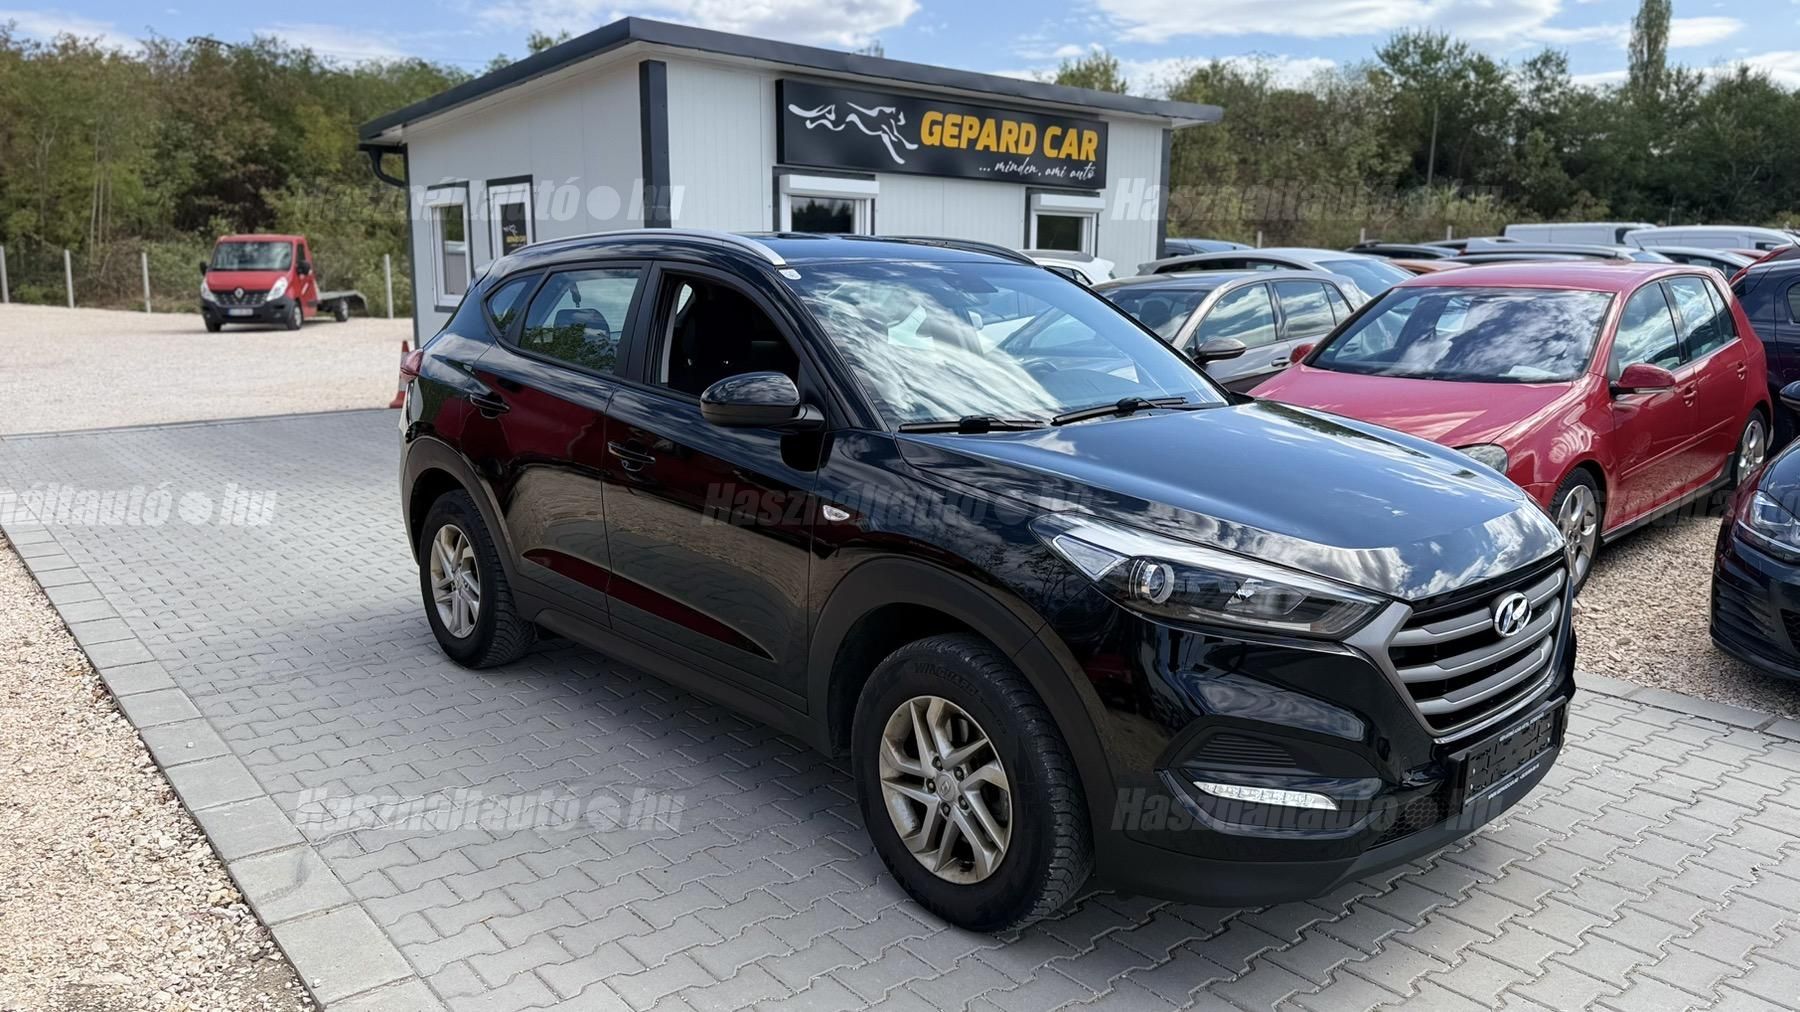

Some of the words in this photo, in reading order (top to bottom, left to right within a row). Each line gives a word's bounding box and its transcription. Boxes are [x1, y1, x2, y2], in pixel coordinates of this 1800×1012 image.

[920, 110, 1037, 156] GEPARD
[1043, 126, 1098, 161] CAR
[1045, 166, 1067, 178] ami
